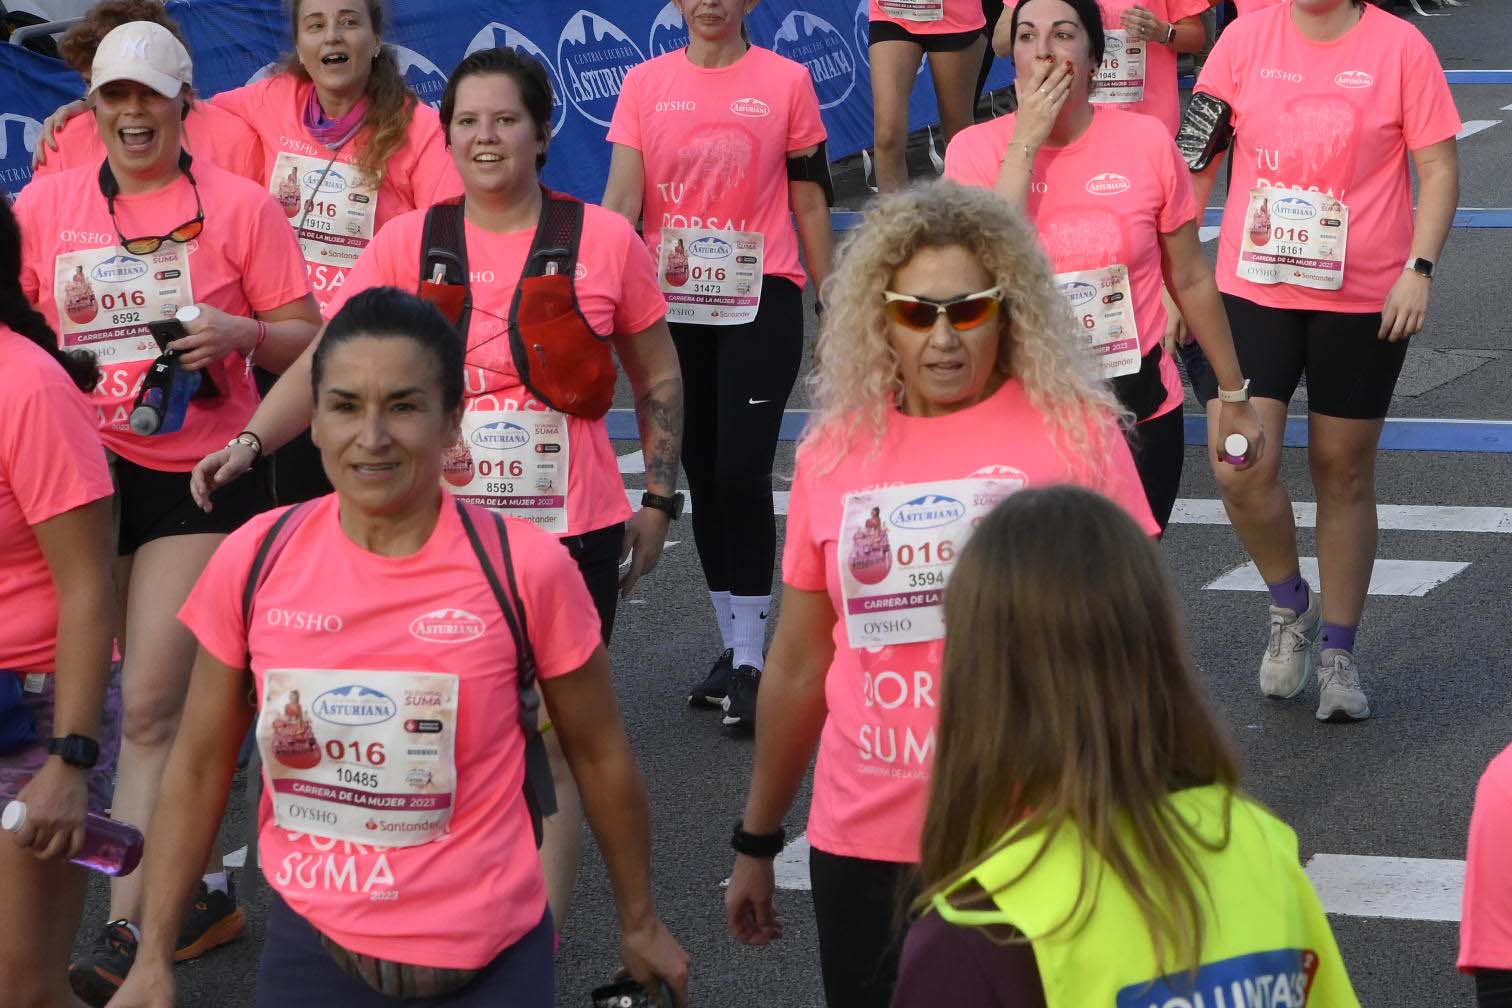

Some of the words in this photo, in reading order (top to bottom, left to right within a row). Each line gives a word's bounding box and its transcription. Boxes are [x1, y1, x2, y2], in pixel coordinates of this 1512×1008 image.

[656, 101, 696, 112] OYSHO
[1256, 148, 1279, 170] TU
[657, 183, 686, 203] TU
[1275, 204, 1312, 216] ASTURIANA
[306, 218, 331, 231] 19173
[60, 231, 112, 244] OYSHO
[1275, 227, 1309, 242] 016
[1276, 246, 1302, 255] 18161
[97, 266, 144, 278] ASTURIANA
[692, 267, 726, 280] 016
[1302, 272, 1334, 282] Santander
[694, 284, 721, 293] 31473
[102, 291, 145, 309] 016
[112, 312, 140, 324] 8592
[78, 333, 113, 342] CARRERA
[476, 433, 525, 443] ASTURIANA
[479, 460, 522, 476] 016
[487, 483, 513, 492] 8593
[895, 508, 959, 523] ASTURIANA
[897, 541, 954, 566] 016
[864, 597, 908, 609] CARRERA
[911, 595, 923, 604] DE
[926, 594, 938, 603] LA
[267, 608, 343, 633] OYSHO
[864, 618, 911, 633] OYSHO
[318, 701, 389, 716] ASTURIANA
[405, 696, 441, 706] SUMA
[326, 740, 385, 766] 016
[336, 768, 378, 788] 10485
[293, 784, 336, 800] CARRERA
[339, 791, 352, 802] DE
[354, 794, 367, 804] LA
[368, 795, 406, 807] MUJER
[410, 798, 435, 807] 2023
[289, 804, 337, 824] OYSHO
[276, 853, 395, 892] SUMA
